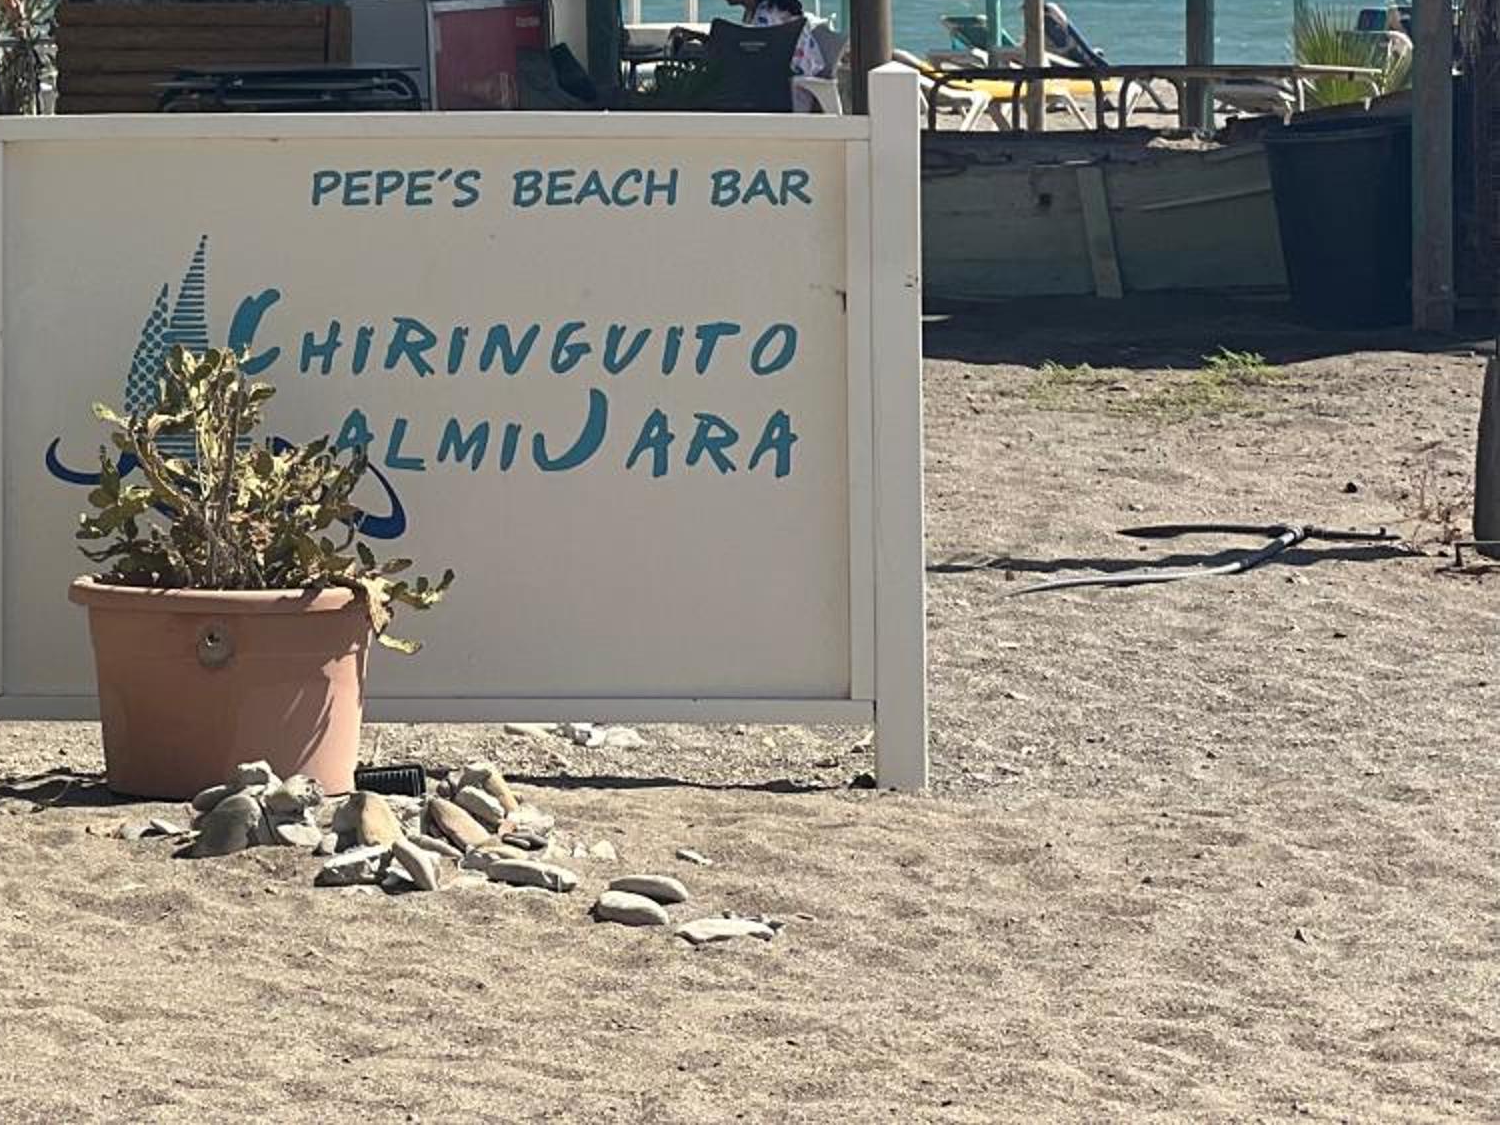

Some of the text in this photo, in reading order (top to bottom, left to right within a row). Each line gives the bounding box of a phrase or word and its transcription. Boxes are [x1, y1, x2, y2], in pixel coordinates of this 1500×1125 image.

[512, 168, 679, 207] BEACH
[710, 168, 813, 207] BAR
[227, 288, 799, 377] CHIRINGUITO
[334, 388, 799, 478] ALMIJARA
